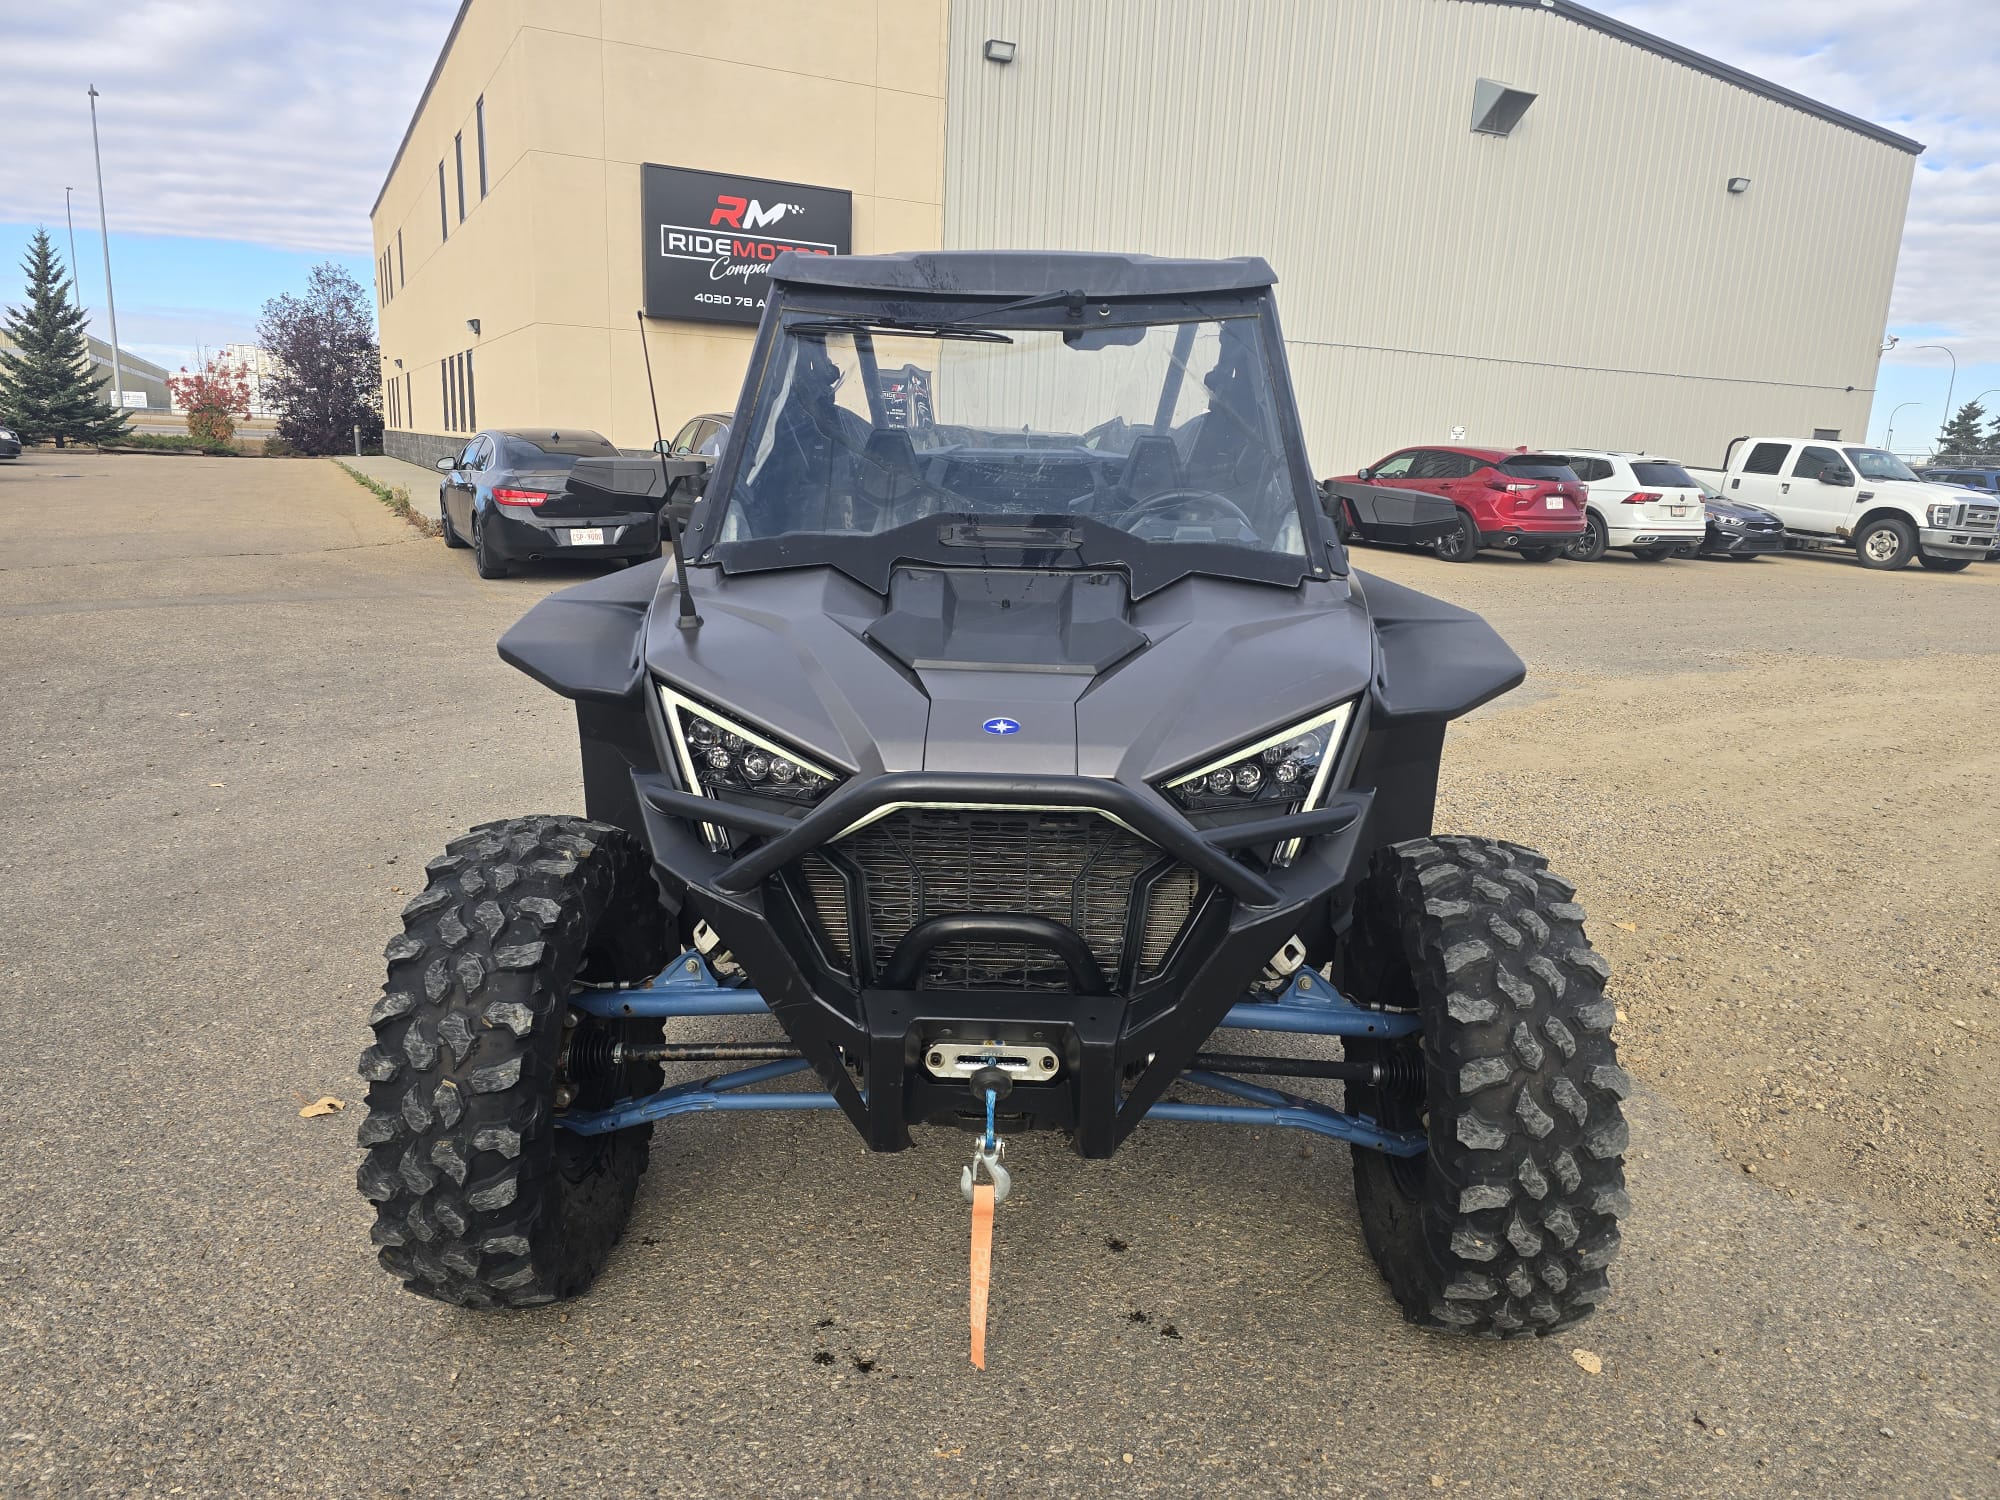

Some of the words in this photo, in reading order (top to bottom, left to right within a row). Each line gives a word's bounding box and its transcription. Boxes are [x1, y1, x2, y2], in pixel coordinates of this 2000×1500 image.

[709, 194, 787, 230] RM
[668, 232, 829, 261] RIDEMO
[709, 256, 770, 285] Compa
[694, 293, 732, 305] 4030
[734, 296, 753, 307] 78
[972, 1247, 989, 1331] POLARIS
